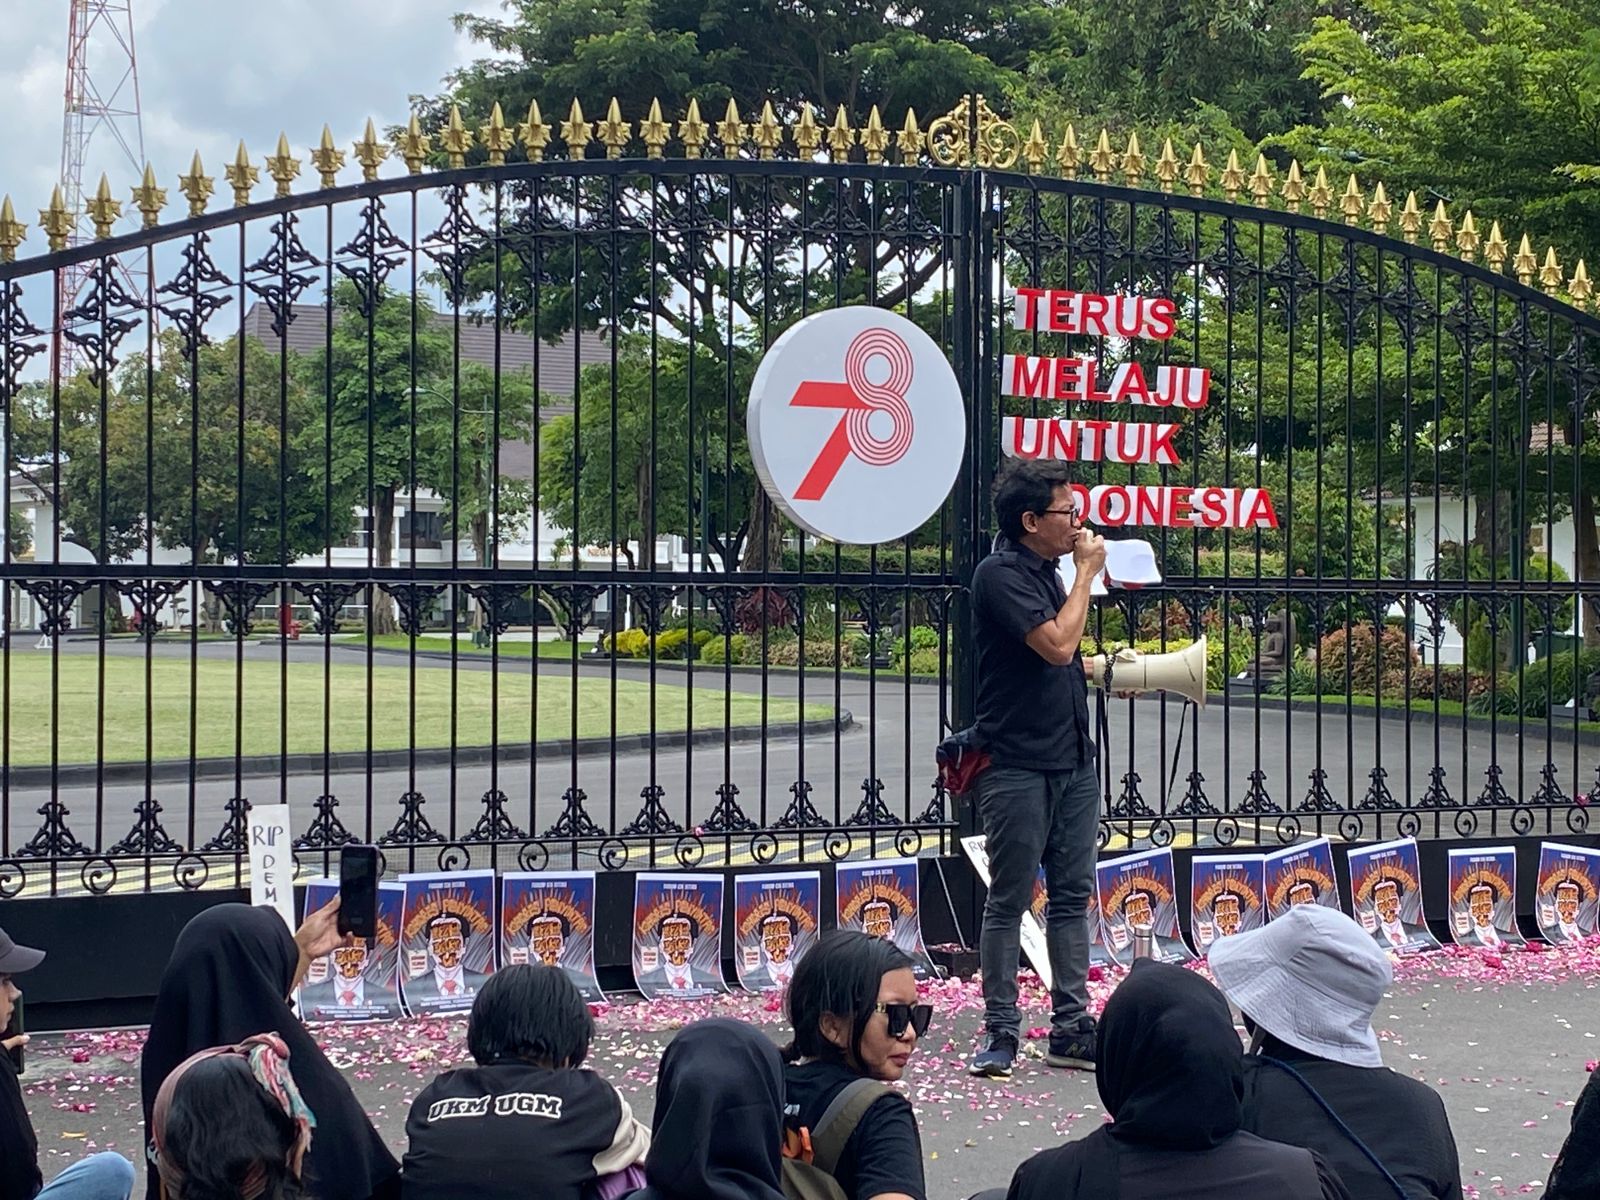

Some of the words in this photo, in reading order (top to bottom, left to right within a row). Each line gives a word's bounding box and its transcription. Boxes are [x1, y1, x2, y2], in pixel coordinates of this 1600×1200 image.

[1015, 287, 1177, 340] TERUS
[1011, 354, 1211, 409] MELAJU
[789, 327, 914, 501] 78
[1012, 416, 1182, 465] UNTUK
[1070, 484, 1279, 528] DONESIA
[252, 825, 284, 847] RIP
[427, 1095, 491, 1122] UKM
[495, 1093, 562, 1119] UGM
